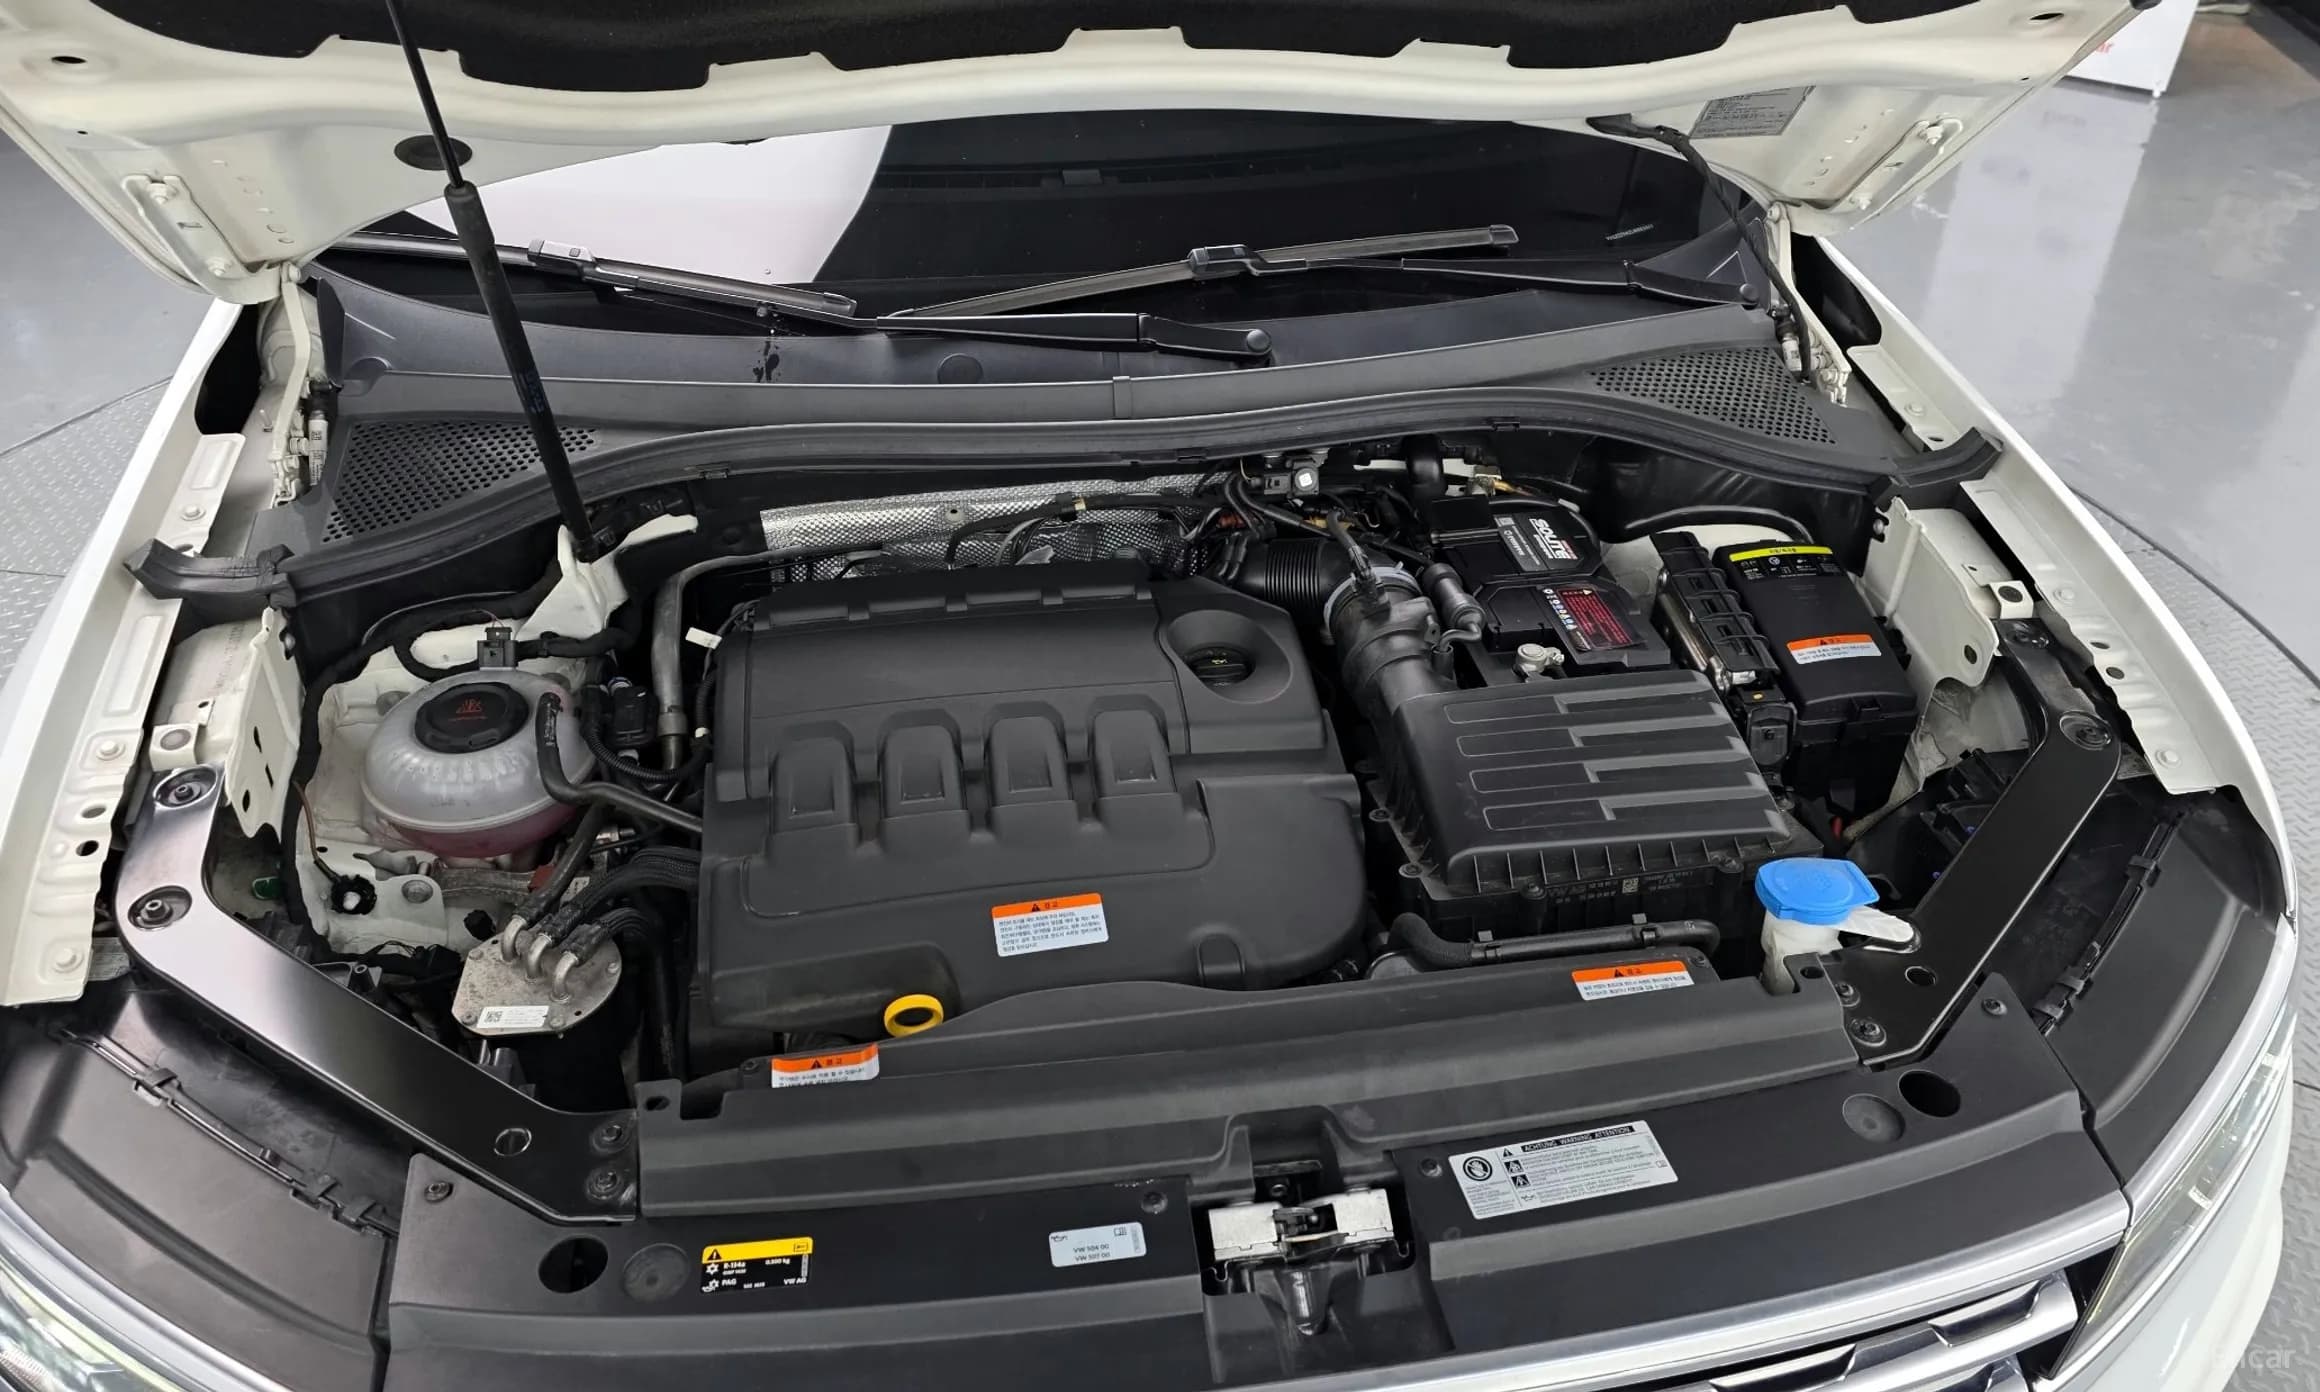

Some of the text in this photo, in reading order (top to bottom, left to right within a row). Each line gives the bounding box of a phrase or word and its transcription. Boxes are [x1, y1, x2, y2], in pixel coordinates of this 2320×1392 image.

[1536, 518, 1570, 559] SOLITE
[1524, 1126, 1630, 1152] ACHTUNG WARNING ATTENTION
[721, 1278, 737, 1286] PAG
